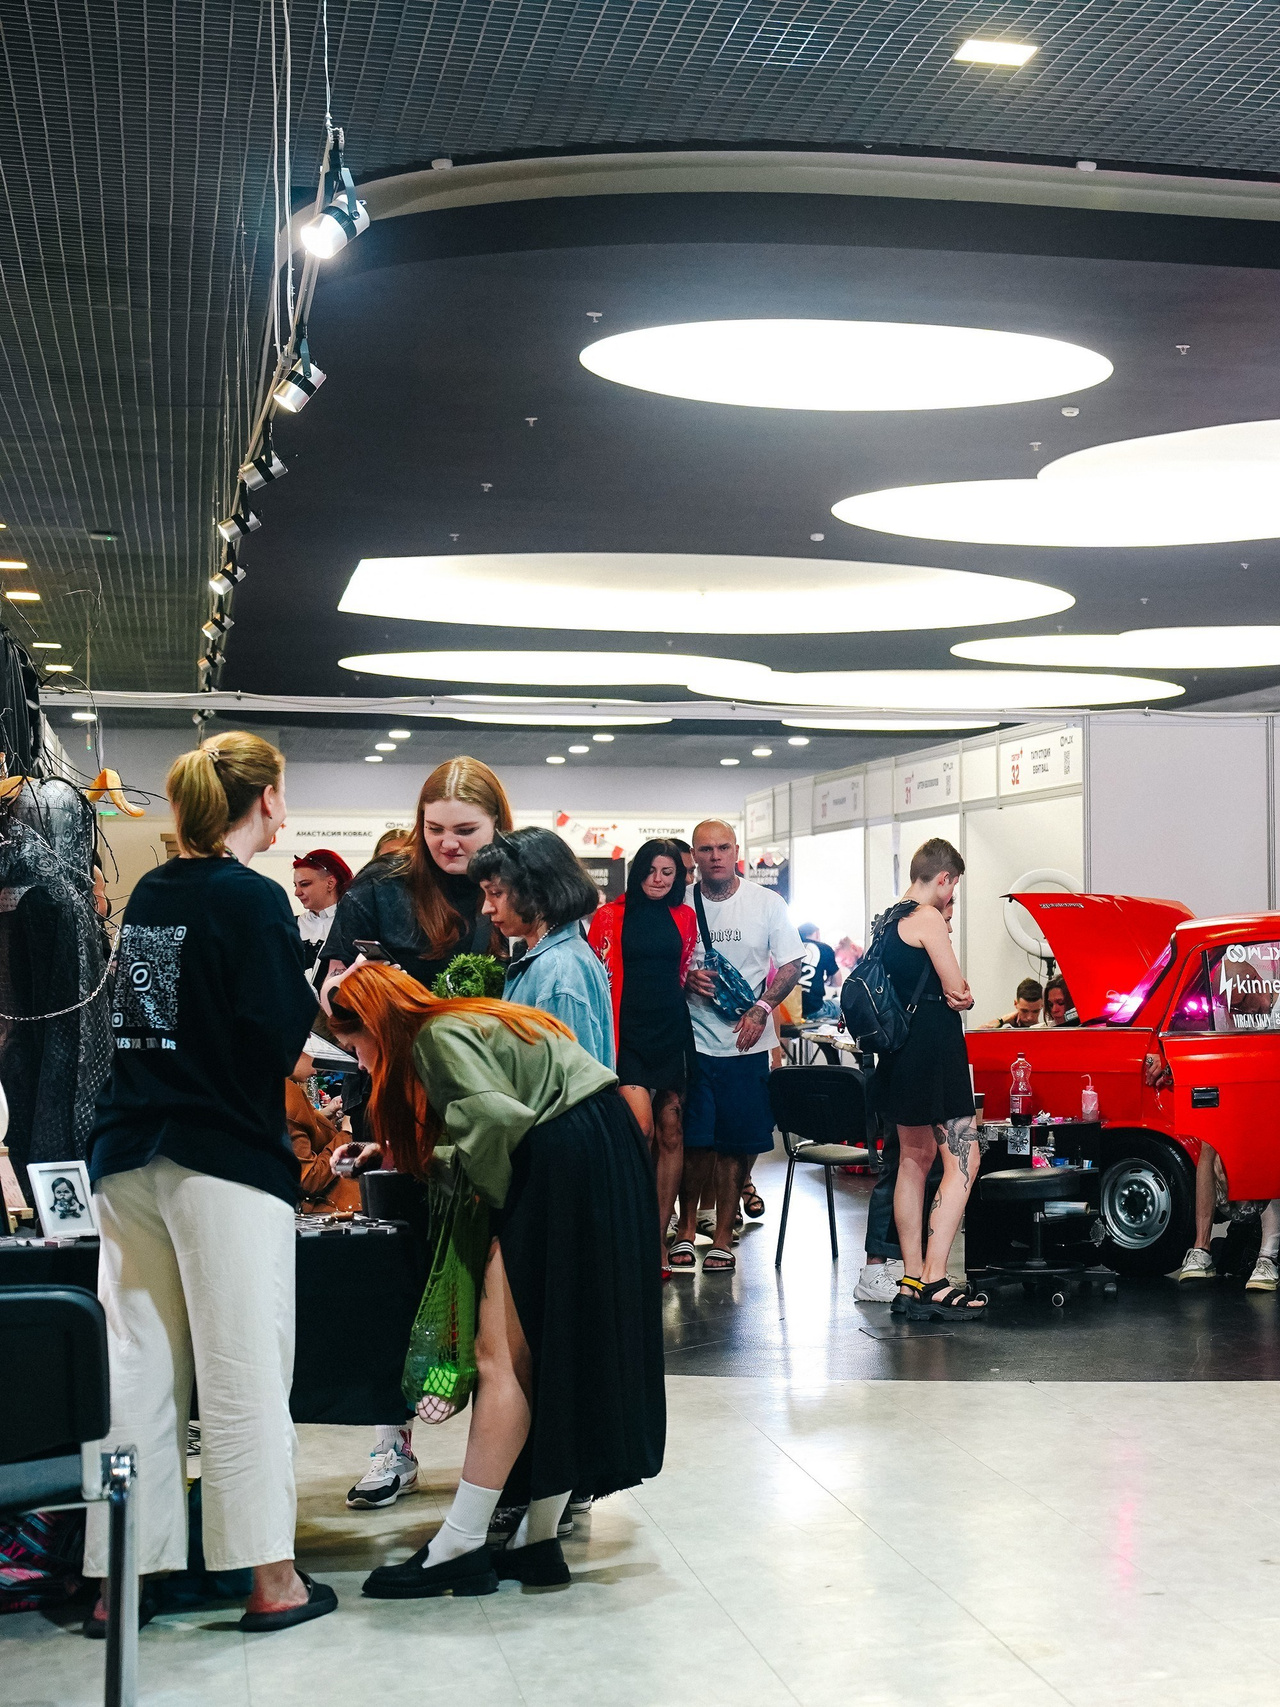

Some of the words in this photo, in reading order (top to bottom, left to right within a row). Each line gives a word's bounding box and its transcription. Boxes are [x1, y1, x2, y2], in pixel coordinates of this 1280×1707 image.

[1011, 764, 1020, 786] 32
[1233, 1013, 1254, 1028] VIRGIN
[1255, 1013, 1271, 1028] SKIN
